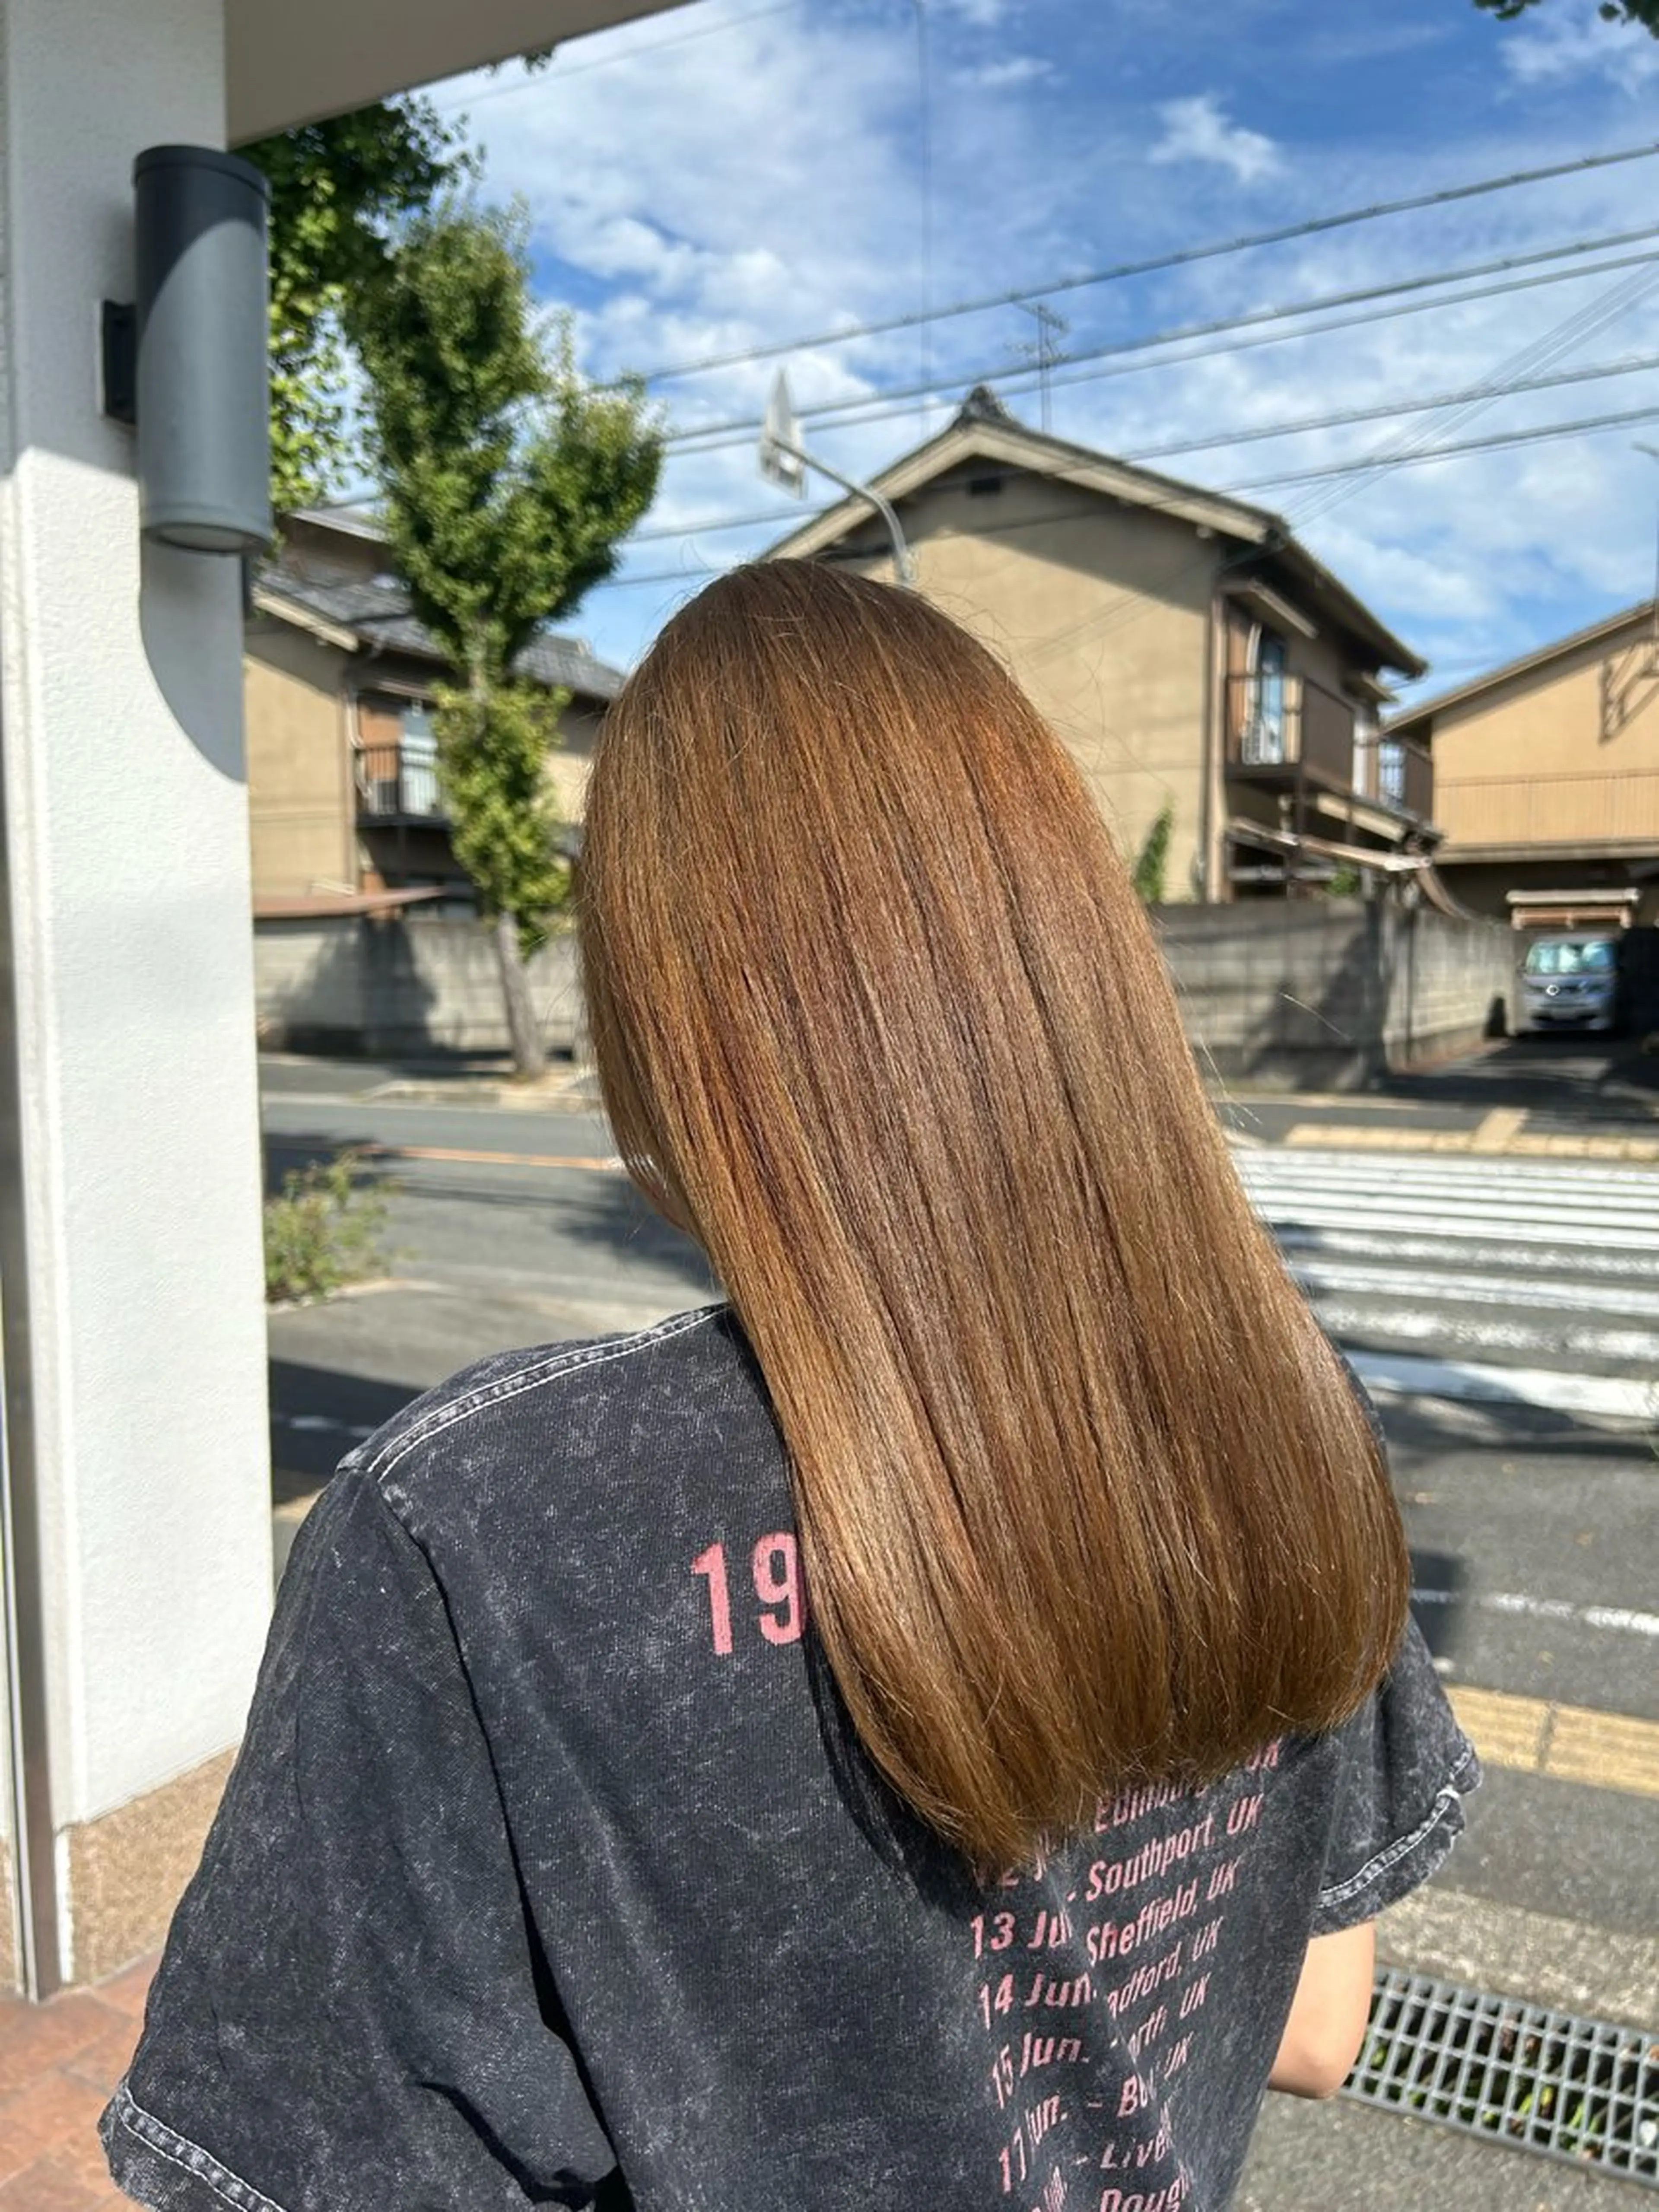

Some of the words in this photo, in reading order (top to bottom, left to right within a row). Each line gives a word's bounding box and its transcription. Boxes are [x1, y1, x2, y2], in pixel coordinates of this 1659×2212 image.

[691, 1532, 802, 1656] 19
[1226, 1792, 1264, 1836] UK
[970, 1910, 1015, 1960] 13
[1206, 1853, 1242, 1901] UK
[979, 1973, 1014, 2031] 14
[1024, 1970, 1097, 2007] Jun.
[1107, 1940, 1183, 2021] adford,
[1192, 1915, 1224, 1962] UK
[1019, 2031, 1090, 2078] Jun.
[1179, 1971, 1211, 2020] UK
